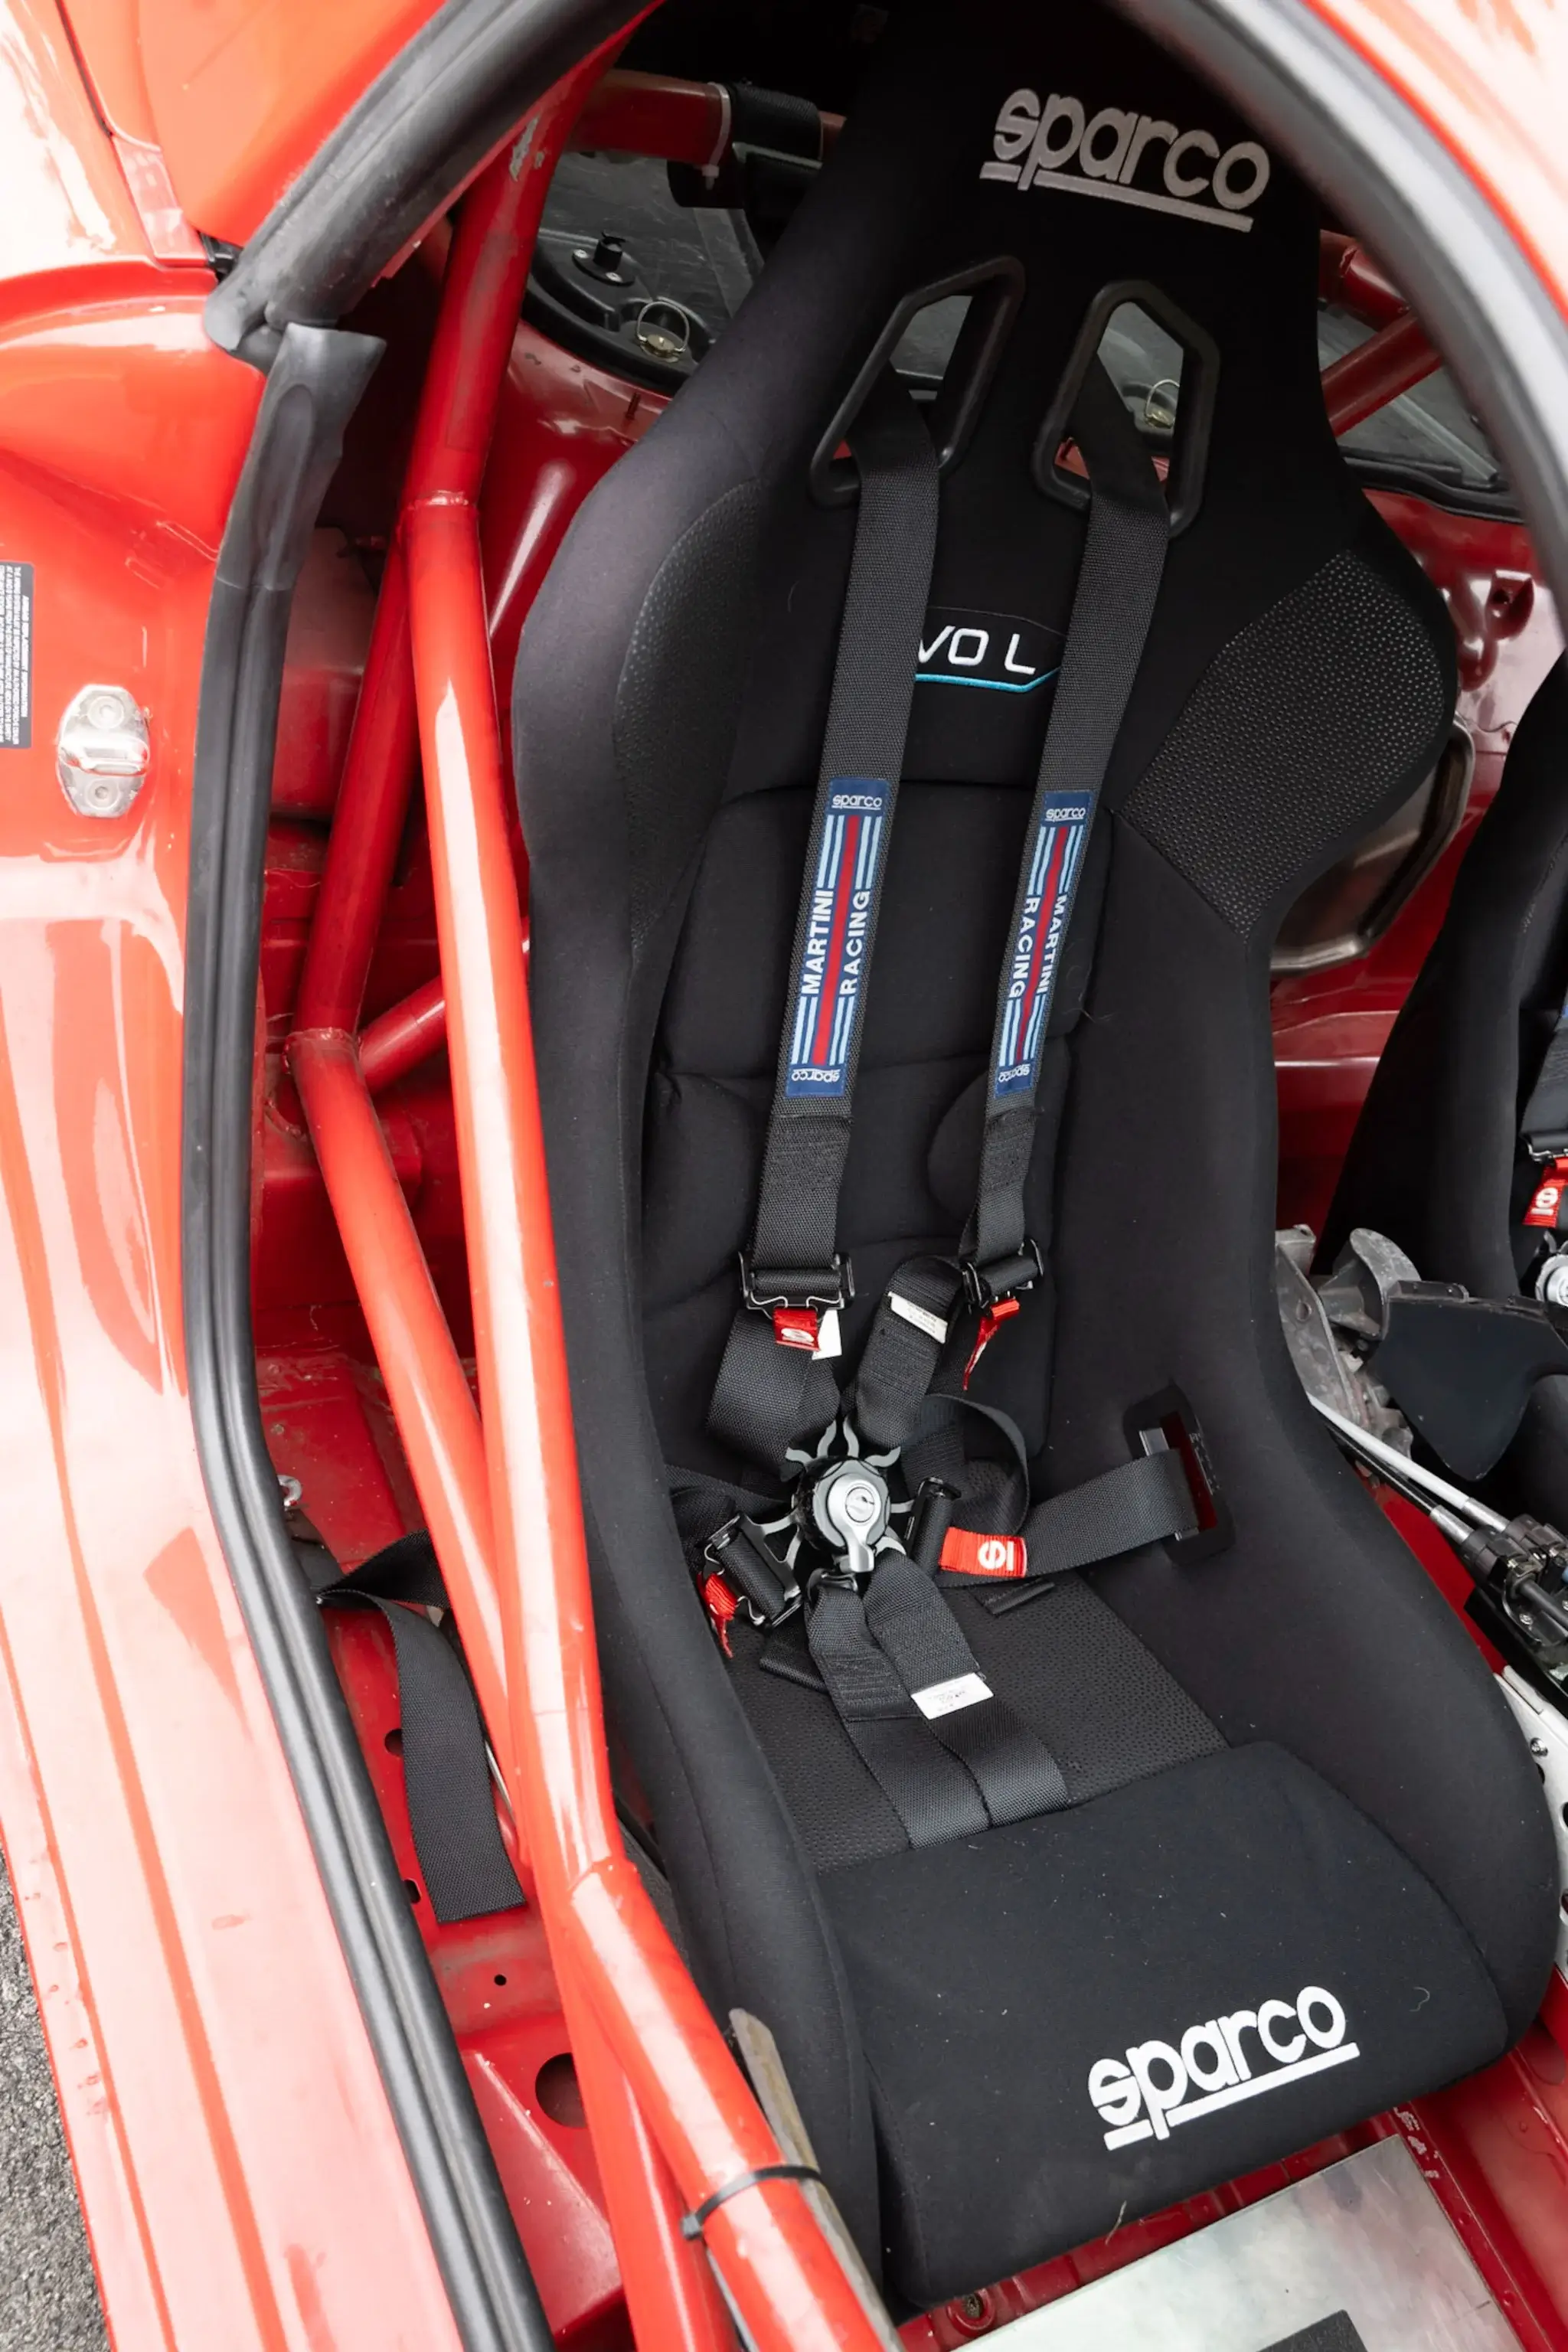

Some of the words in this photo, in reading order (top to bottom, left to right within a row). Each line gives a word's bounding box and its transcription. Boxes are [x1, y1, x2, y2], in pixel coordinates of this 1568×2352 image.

[993, 88, 1271, 210] sparco
[1004, 633, 1036, 675] L
[832, 794, 883, 808] sparco
[1045, 807, 1086, 822] sparco
[801, 890, 835, 995] MARTINI
[839, 890, 871, 995] RACING
[1008, 897, 1041, 998] RACING
[1037, 894, 1067, 994] MARTINI
[1088, 1986, 1346, 2141] sparco
